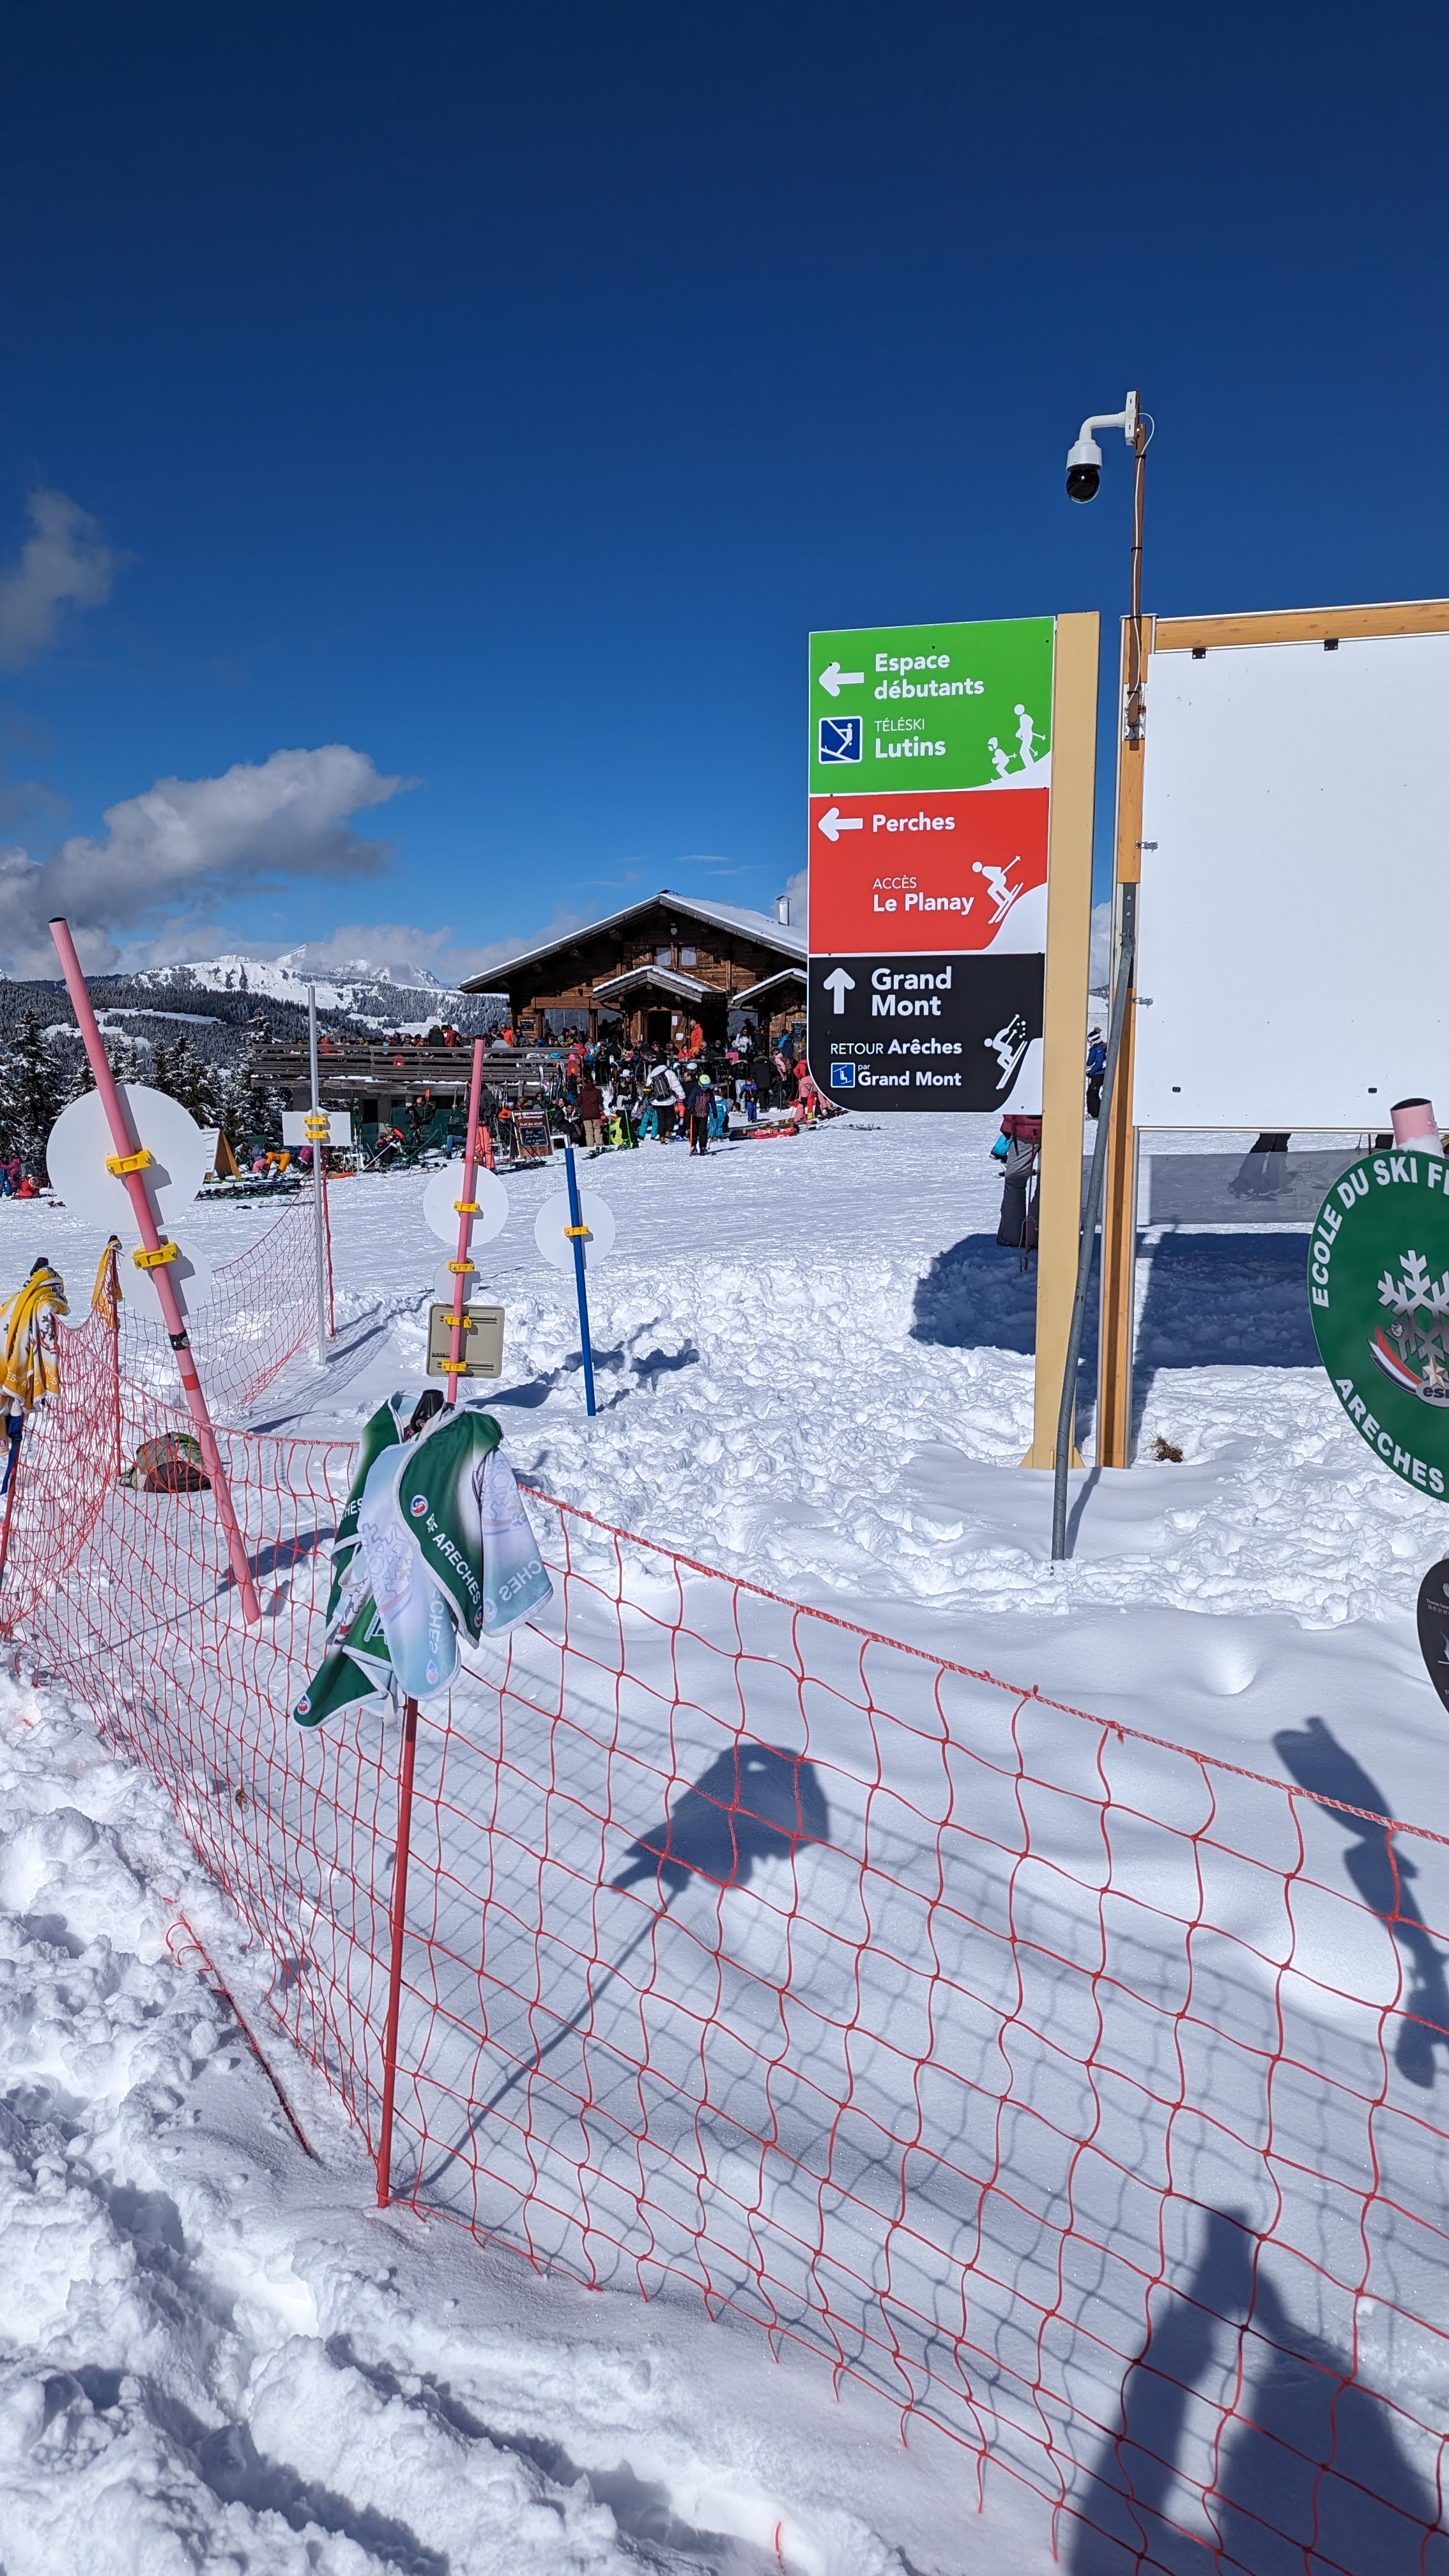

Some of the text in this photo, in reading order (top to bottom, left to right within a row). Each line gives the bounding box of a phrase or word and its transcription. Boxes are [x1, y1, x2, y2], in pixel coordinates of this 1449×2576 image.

[875, 653, 950, 675] Espace
[874, 678, 985, 700] débutants
[874, 718, 925, 733] TÉLÉSKI
[875, 736, 946, 758] Lutins
[873, 811, 955, 832] Perches
[873, 875, 917, 889] ACCÈS
[873, 892, 974, 916] Le Planay
[871, 966, 952, 990] Grand
[871, 995, 942, 1016] Mont
[831, 1038, 962, 1055] RETOUR Arêches
[857, 1063, 871, 1072] par
[858, 1071, 962, 1086] Grand Mont
[1312, 1203, 1343, 1308] ECOLE
[1337, 1167, 1369, 1209] DU
[1374, 1156, 1418, 1186] SKI
[1335, 1379, 1445, 1493] ARECHES
[432, 1533, 481, 1605] ARECHES
